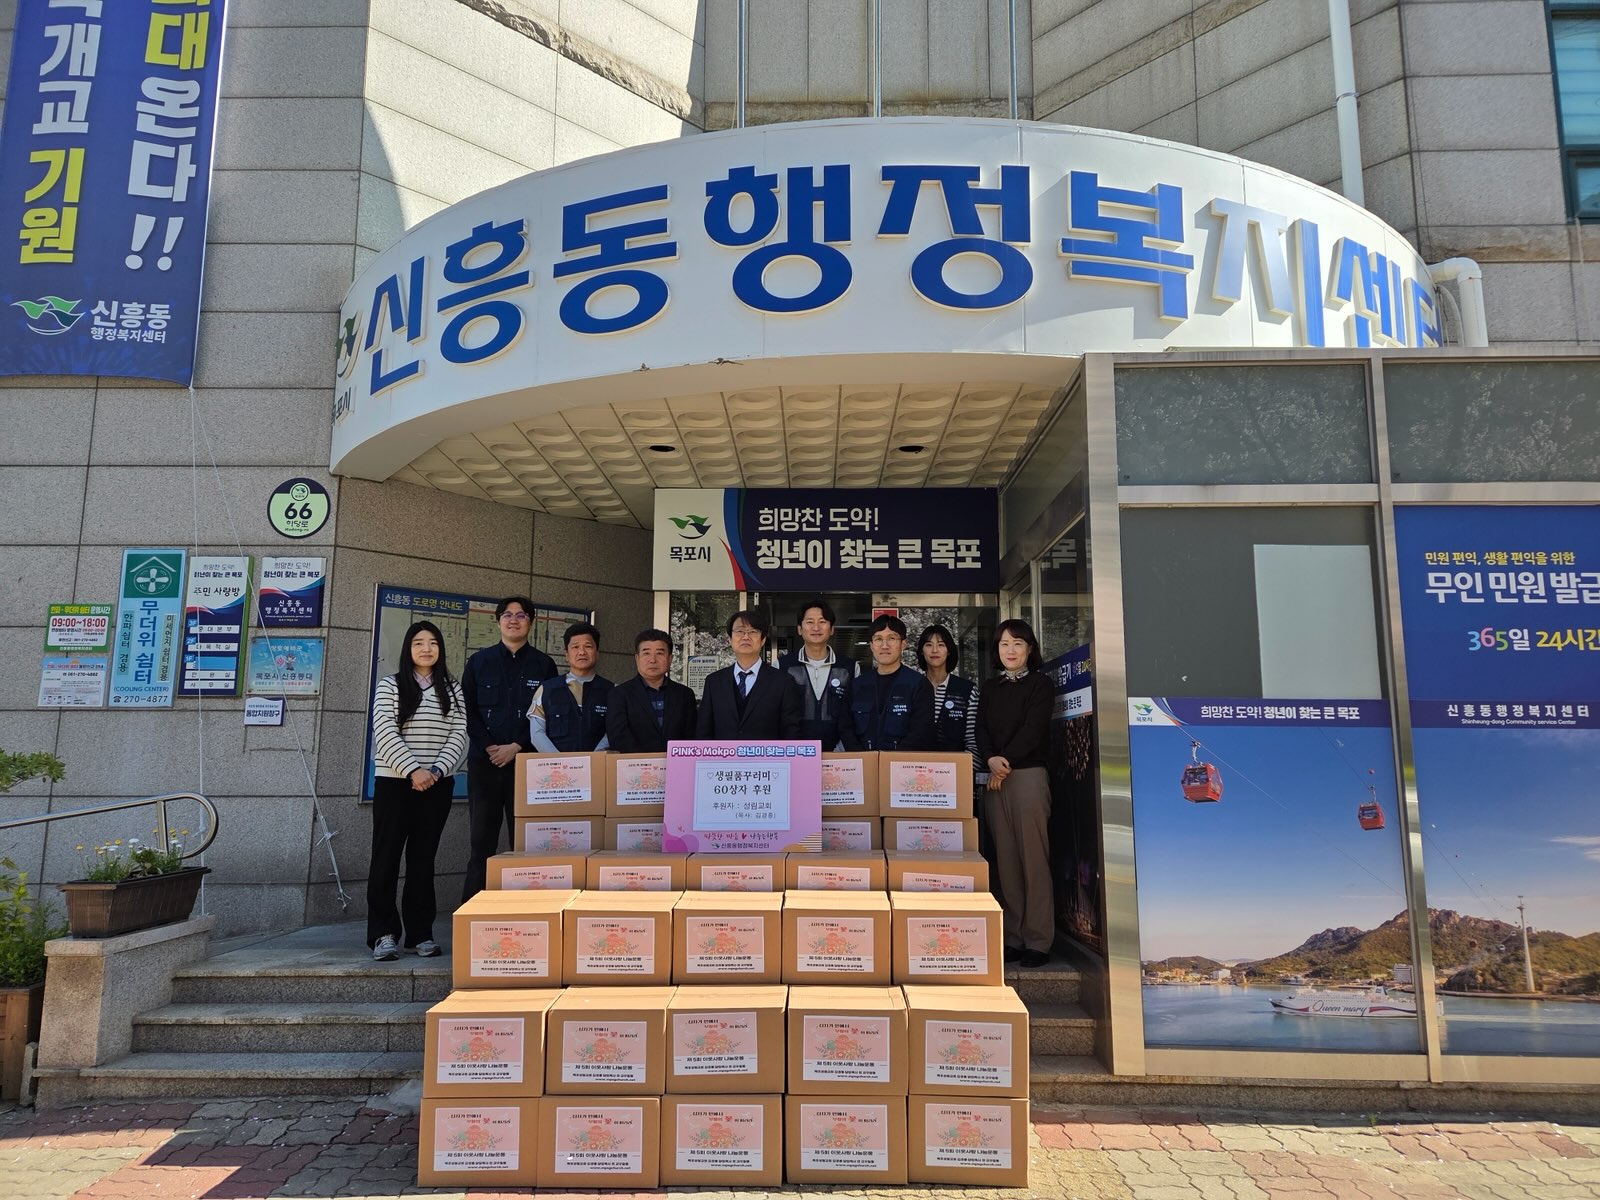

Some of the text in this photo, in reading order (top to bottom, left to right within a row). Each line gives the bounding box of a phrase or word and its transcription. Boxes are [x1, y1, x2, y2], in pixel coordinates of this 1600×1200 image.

[19, 148, 85, 264] 기원
[90, 300, 172, 329] 신흥동
[89, 327, 167, 344] 행정복지센터
[285, 503, 312, 520] 66
[758, 507, 880, 532] 희망찬 도약!
[286, 520, 309, 528] 하당로
[669, 546, 711, 563] 목포시
[756, 538, 982, 569] 청년이 찾는 큰 목포
[1425, 552, 1576, 566] 민원 편익, 생활 편익을 위한
[214, 586, 240, 597] 사랑방
[1424, 572, 1485, 604] 무인
[1488, 572, 1548, 604] 민원
[278, 600, 301, 608] 신흥동
[412, 596, 437, 608] 도로명
[440, 599, 463, 611] 안내도
[52, 618, 106, 628] 09:00~18:00
[134, 600, 160, 684] 무더위 쉼터
[1468, 627, 1531, 651] 365일
[1201, 705, 1360, 720] 희망찬 도약! 청년이 찾는 큰 목포
[1447, 704, 1590, 718] 신흥동행정복지센터
[671, 746, 816, 758] PINK's Mokpo 청년이 찾는 큰 목포
[714, 784, 771, 795] 60상자 후원
[1312, 1000, 1367, 1016] Queen mary
